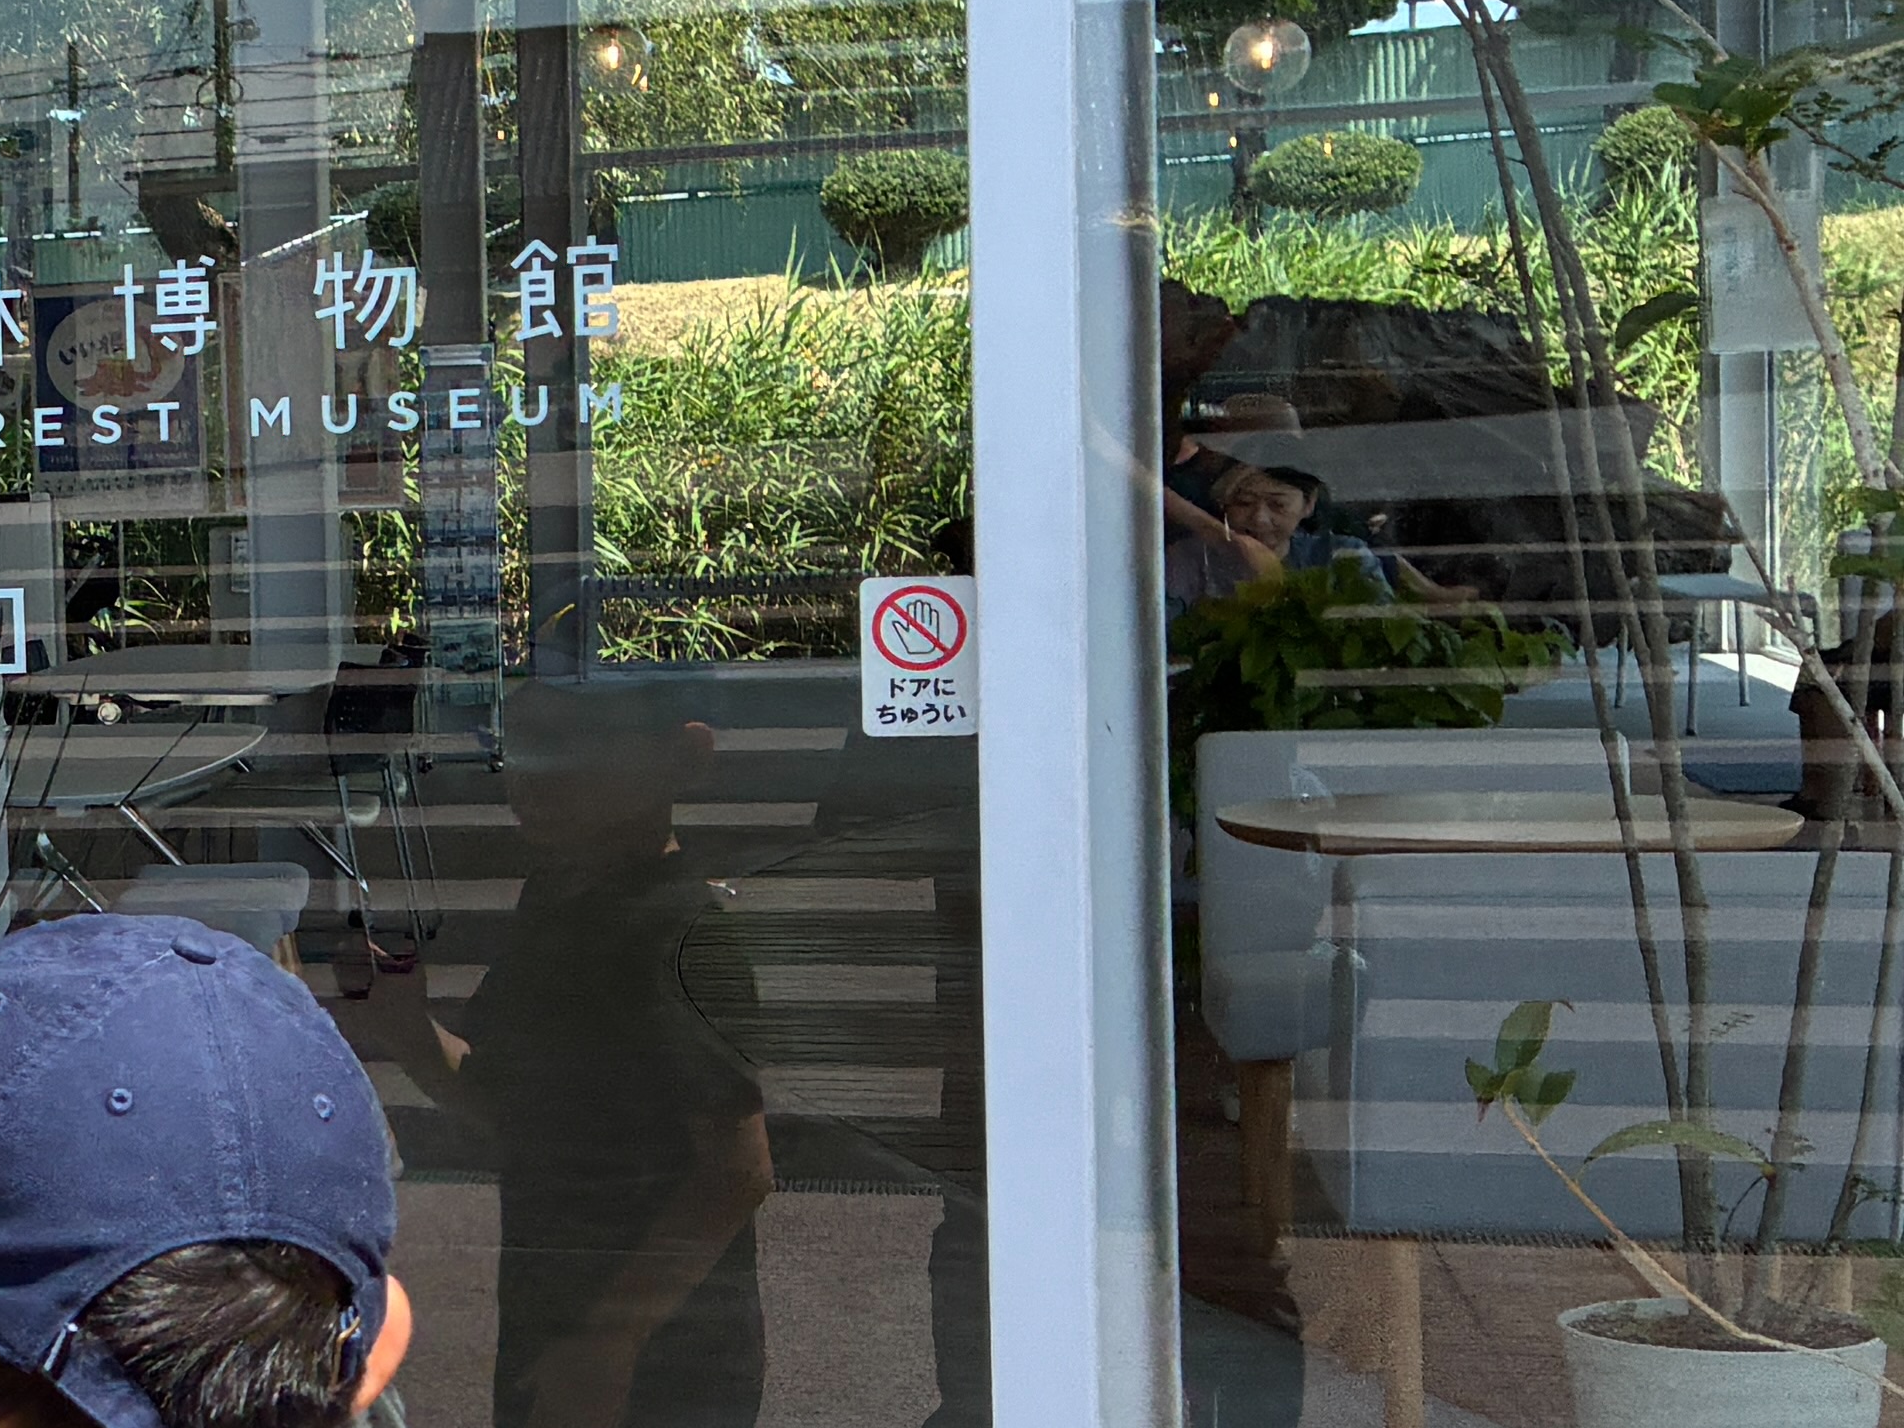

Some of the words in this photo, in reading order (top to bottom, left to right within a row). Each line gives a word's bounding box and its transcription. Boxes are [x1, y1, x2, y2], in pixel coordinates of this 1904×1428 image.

[250, 383, 622, 438] MUSEUM
[889, 677, 956, 699] ドアに
[875, 703, 967, 725] ちゅうい
